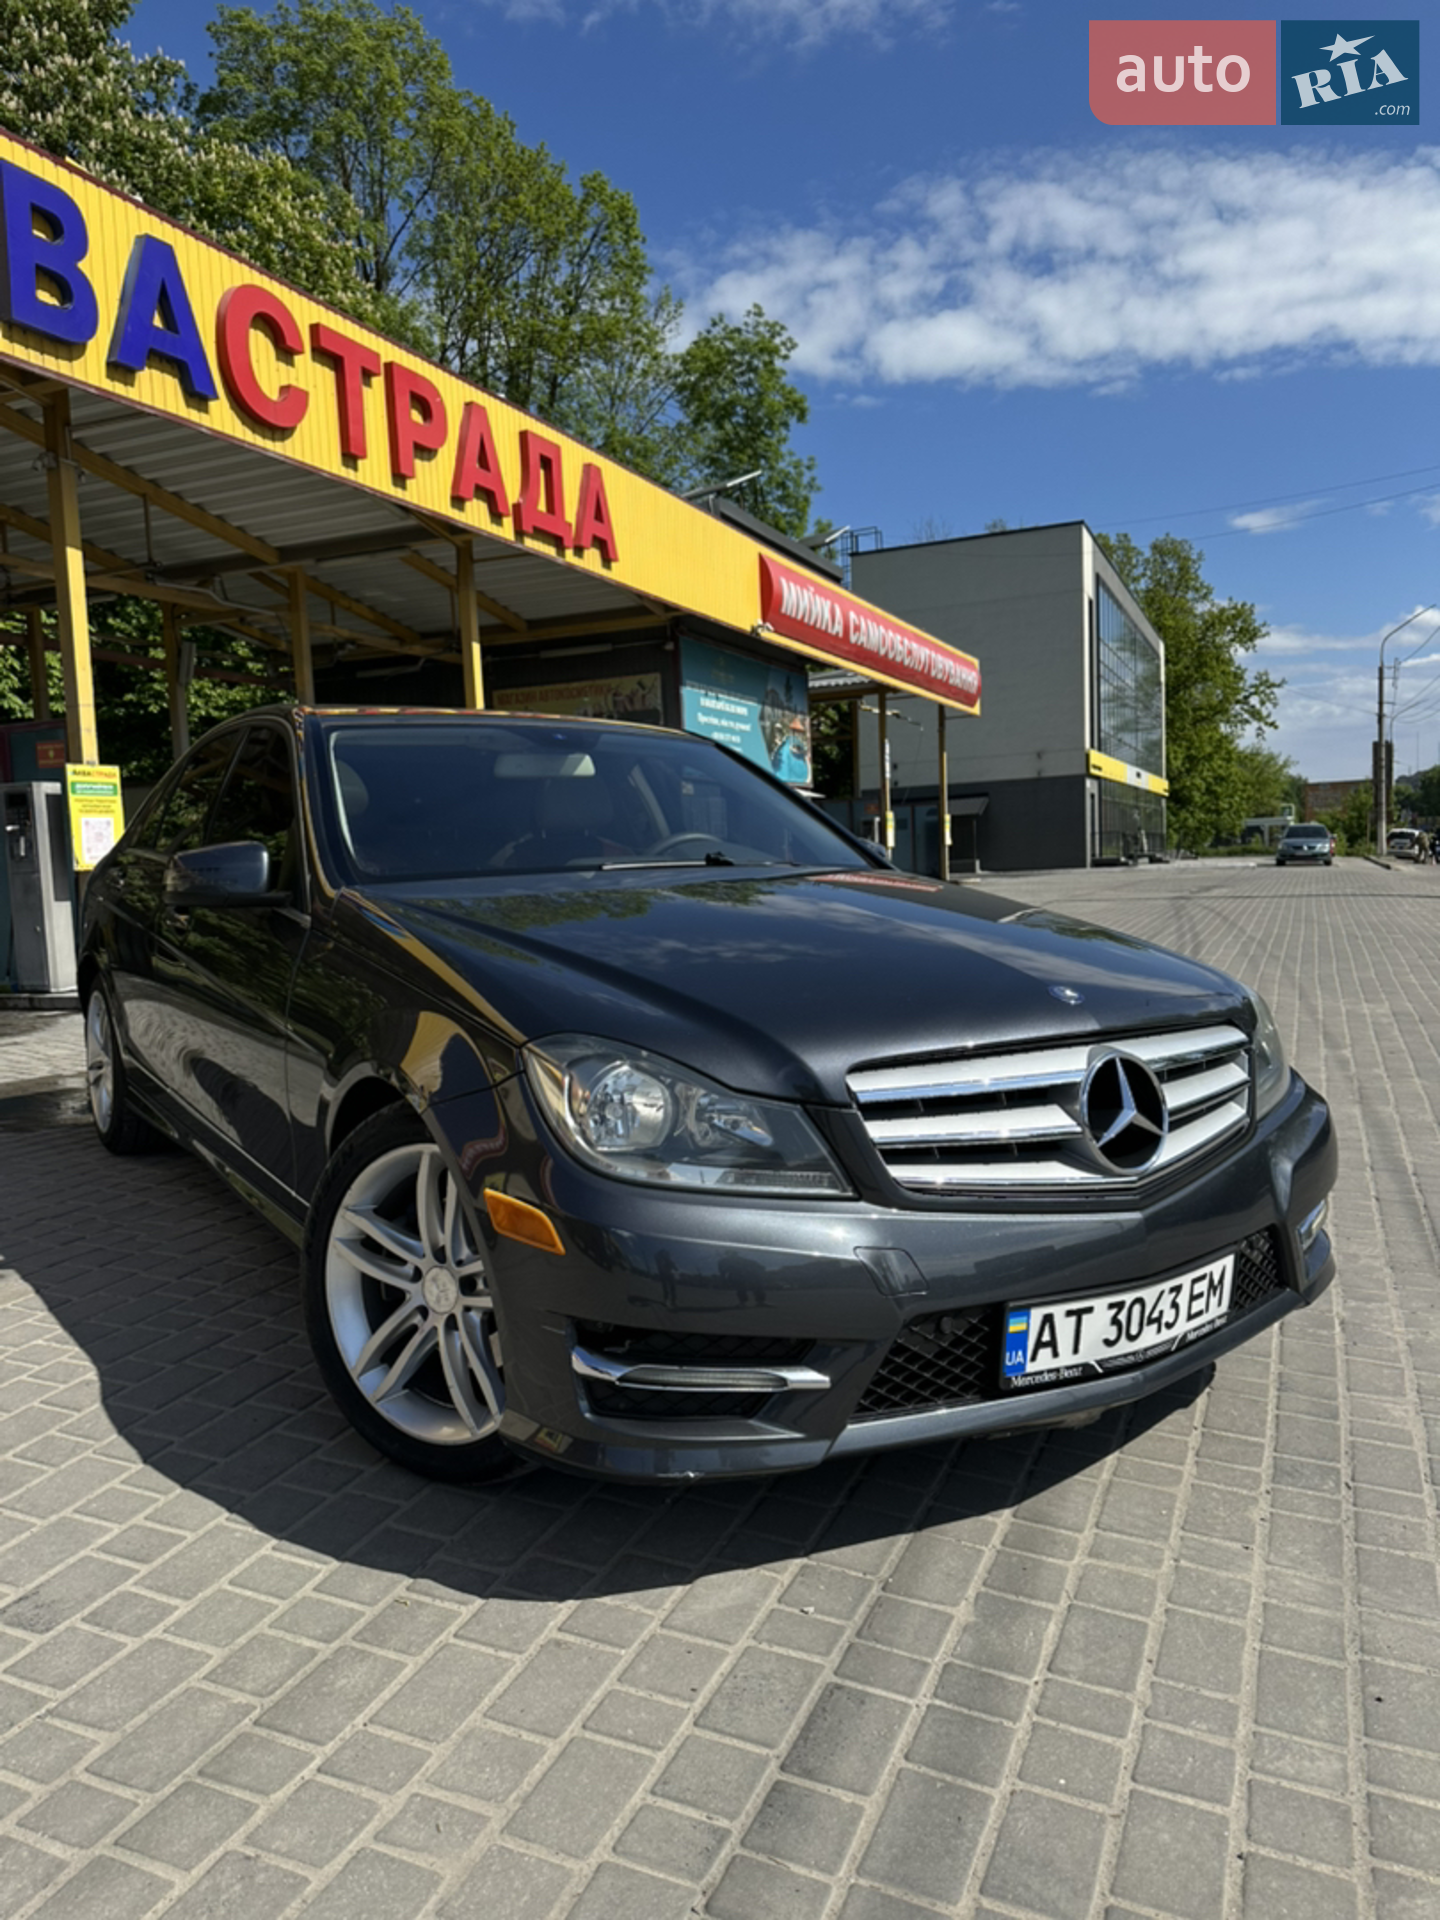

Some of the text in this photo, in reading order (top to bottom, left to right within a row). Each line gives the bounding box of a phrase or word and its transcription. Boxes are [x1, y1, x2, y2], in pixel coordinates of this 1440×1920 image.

[779, 576, 844, 639] МИЙКА
[1029, 1265, 1227, 1363] AT 3043 EM
[1005, 1349, 1025, 1366] UA
